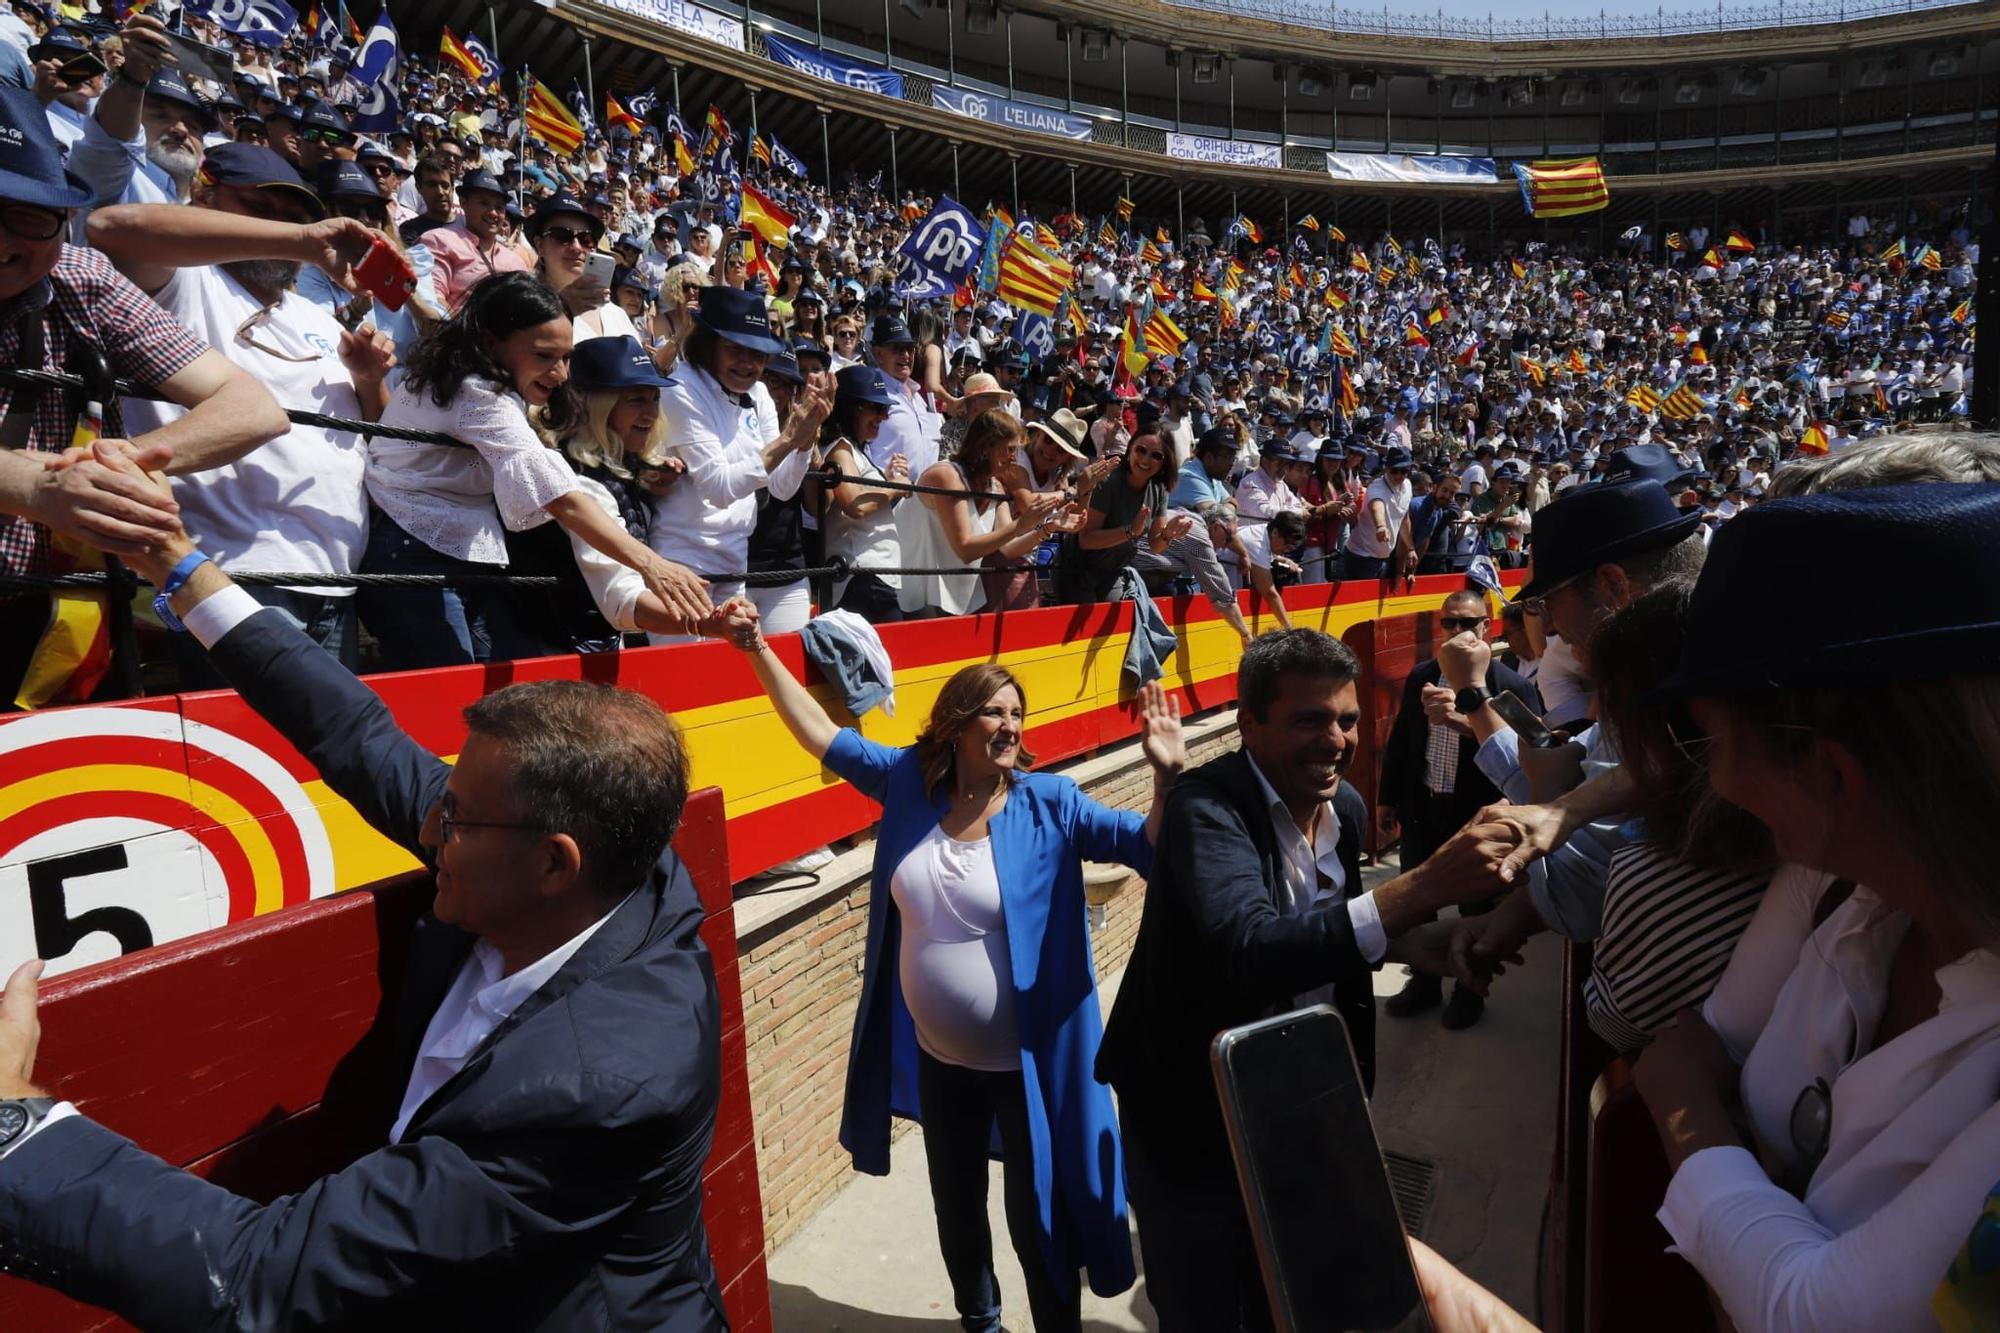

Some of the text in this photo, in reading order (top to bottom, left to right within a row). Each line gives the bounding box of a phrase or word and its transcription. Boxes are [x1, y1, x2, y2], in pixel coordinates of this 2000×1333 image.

[788, 54, 835, 83] VOTA
[1004, 106, 1067, 132] L'ELIANA
[1171, 147, 1194, 158] CON
[1194, 138, 1255, 156] ORIHUELA
[27, 843, 154, 960] 5
